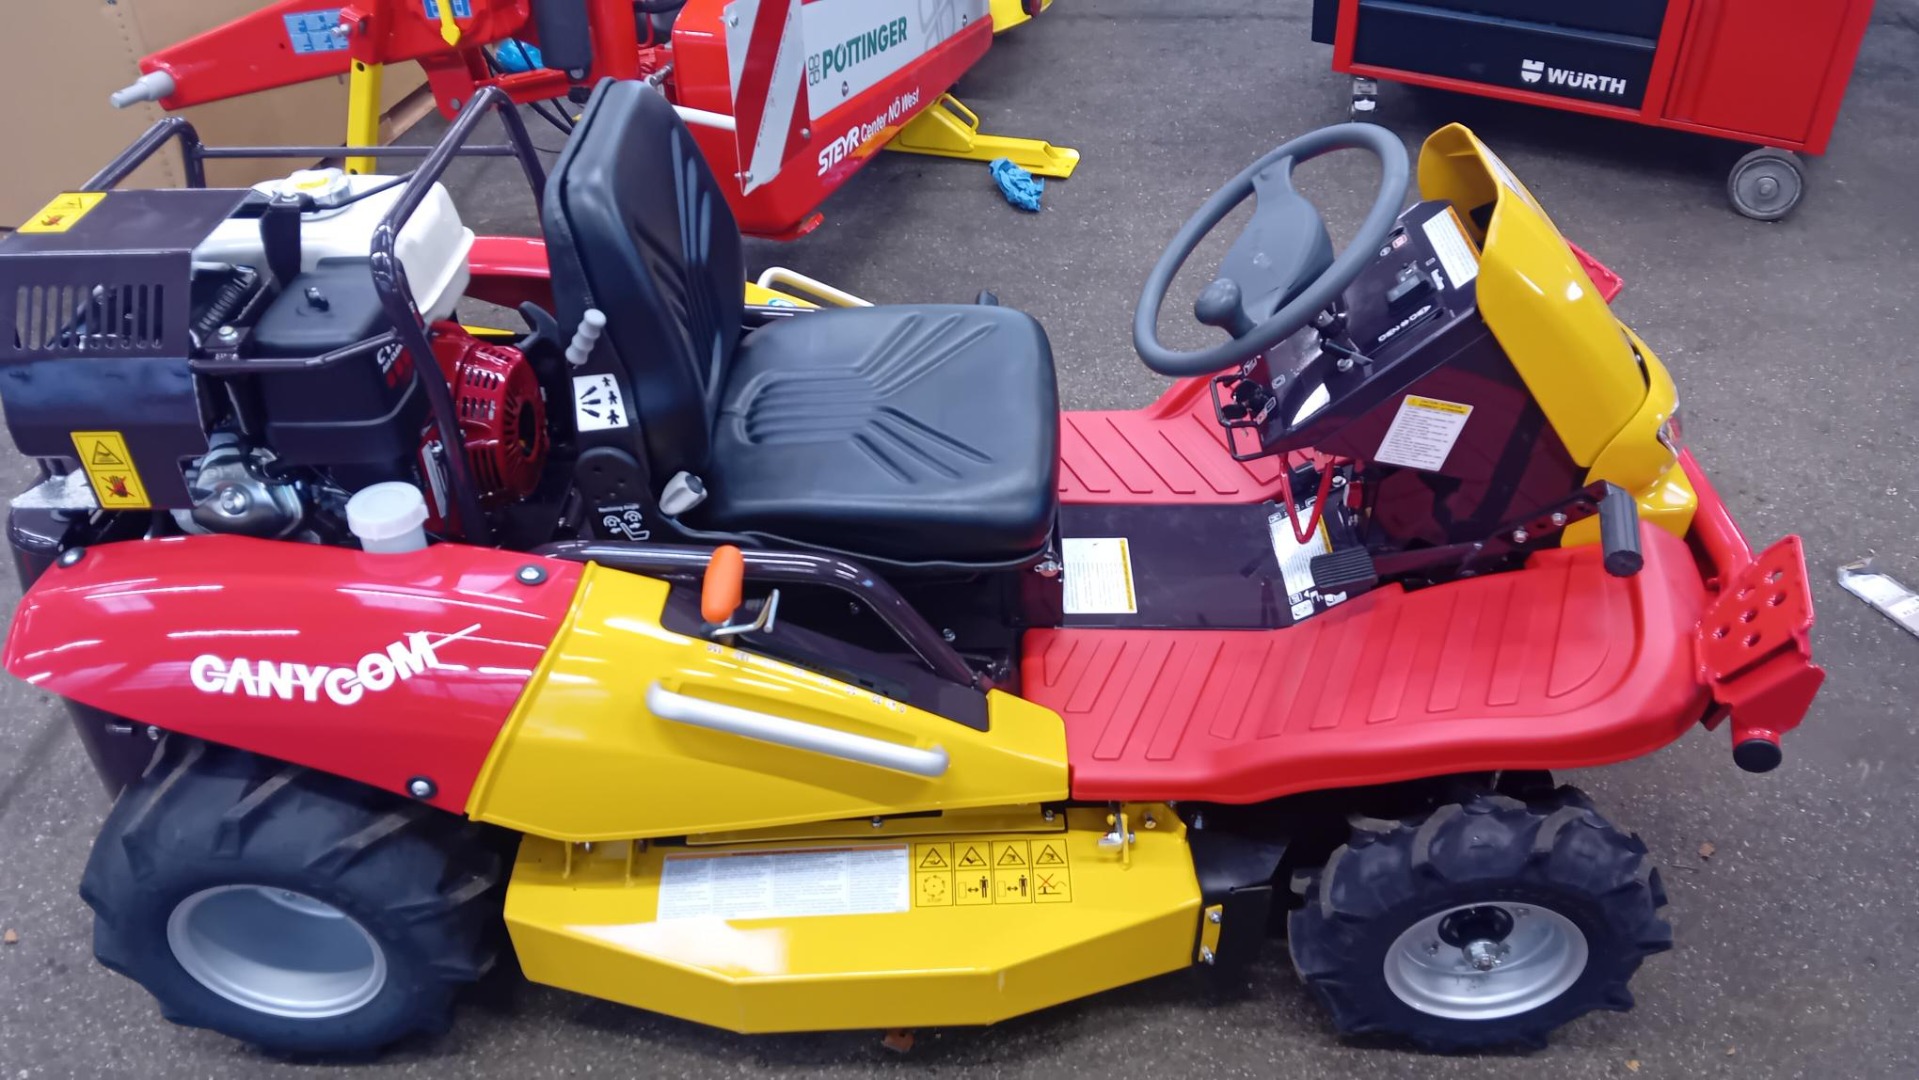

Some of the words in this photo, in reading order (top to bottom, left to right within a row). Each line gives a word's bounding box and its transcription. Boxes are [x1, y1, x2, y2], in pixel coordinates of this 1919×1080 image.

[1547, 67, 1627, 94] WÜRTH
[818, 126, 859, 177] STEYR
[861, 113, 887, 142] Center
[888, 96, 900, 123] NÖ
[901, 87, 919, 113] West
[190, 630, 444, 705] CANYCOM
